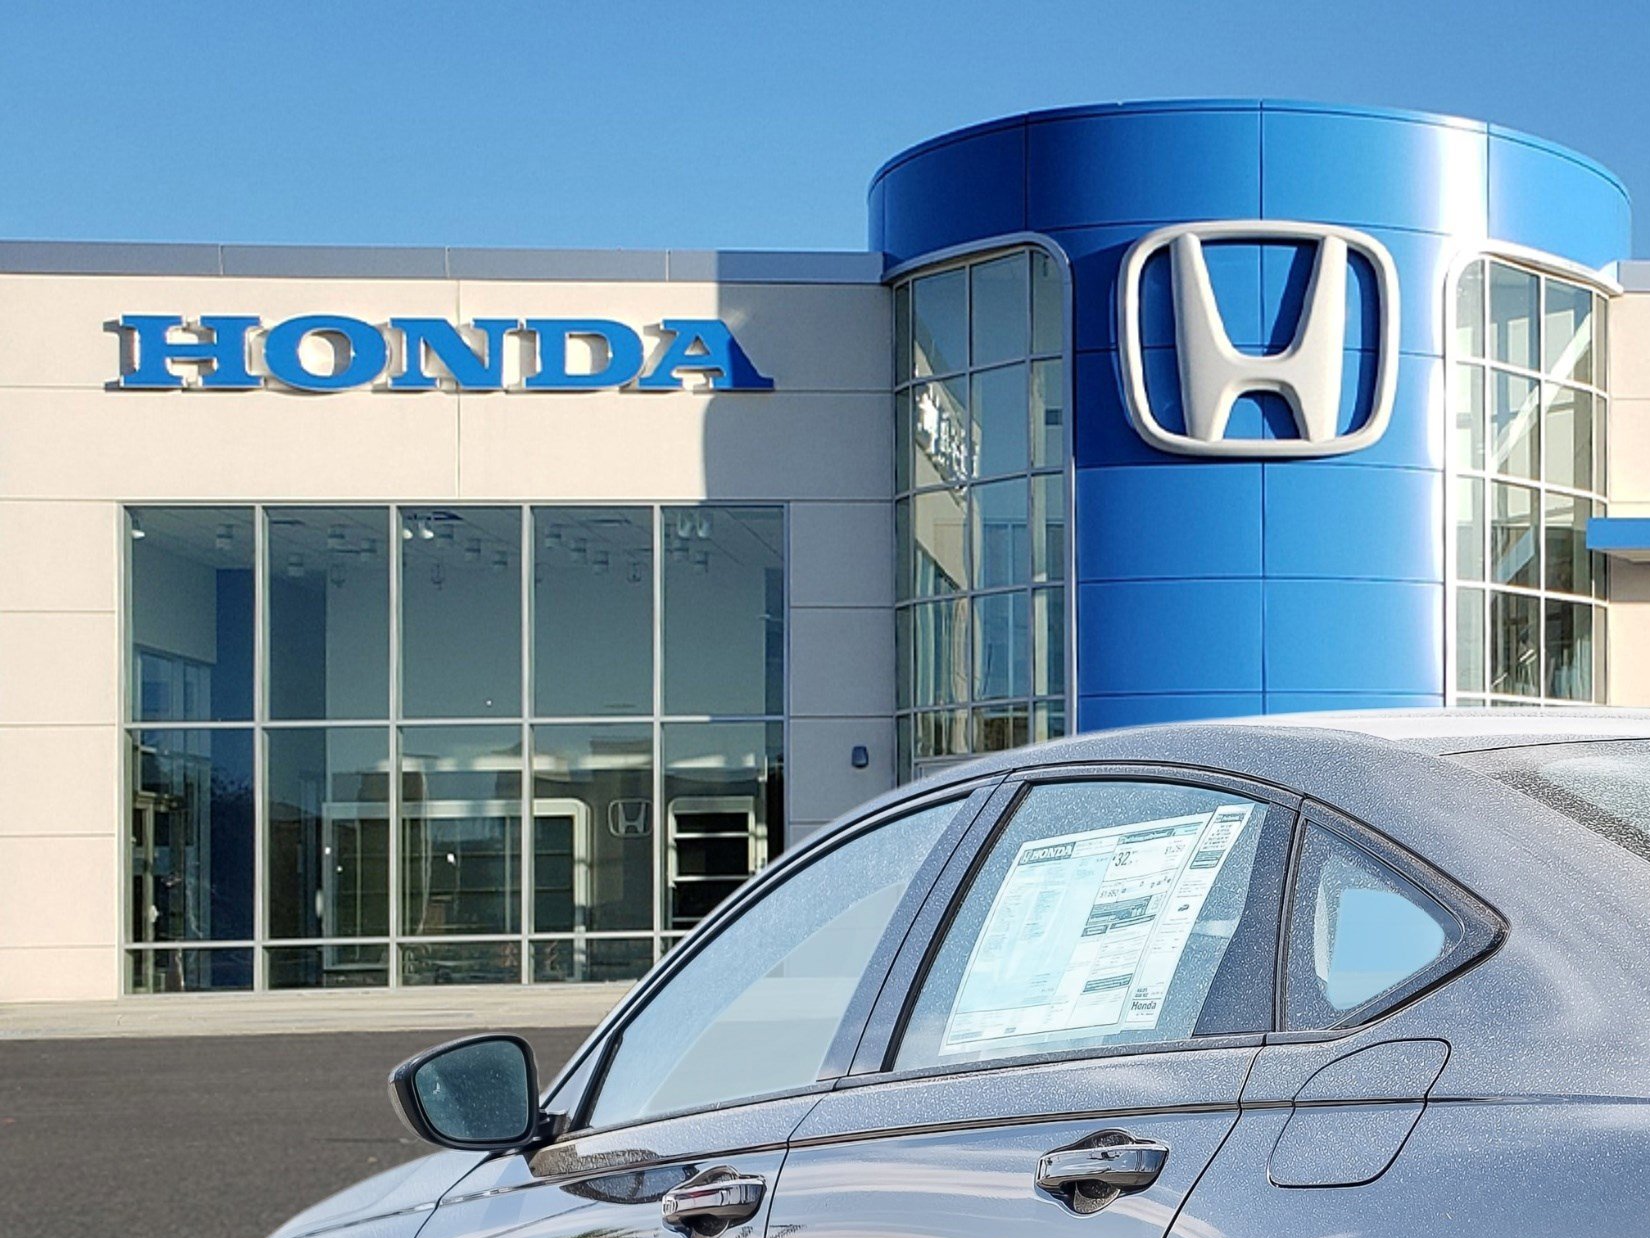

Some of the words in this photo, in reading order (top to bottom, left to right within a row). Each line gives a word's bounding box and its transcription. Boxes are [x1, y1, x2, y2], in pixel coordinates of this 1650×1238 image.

[120, 313, 775, 391] HONDA
[1032, 845, 1073, 861] HONDA
[1130, 1000, 1157, 1011] Honda
